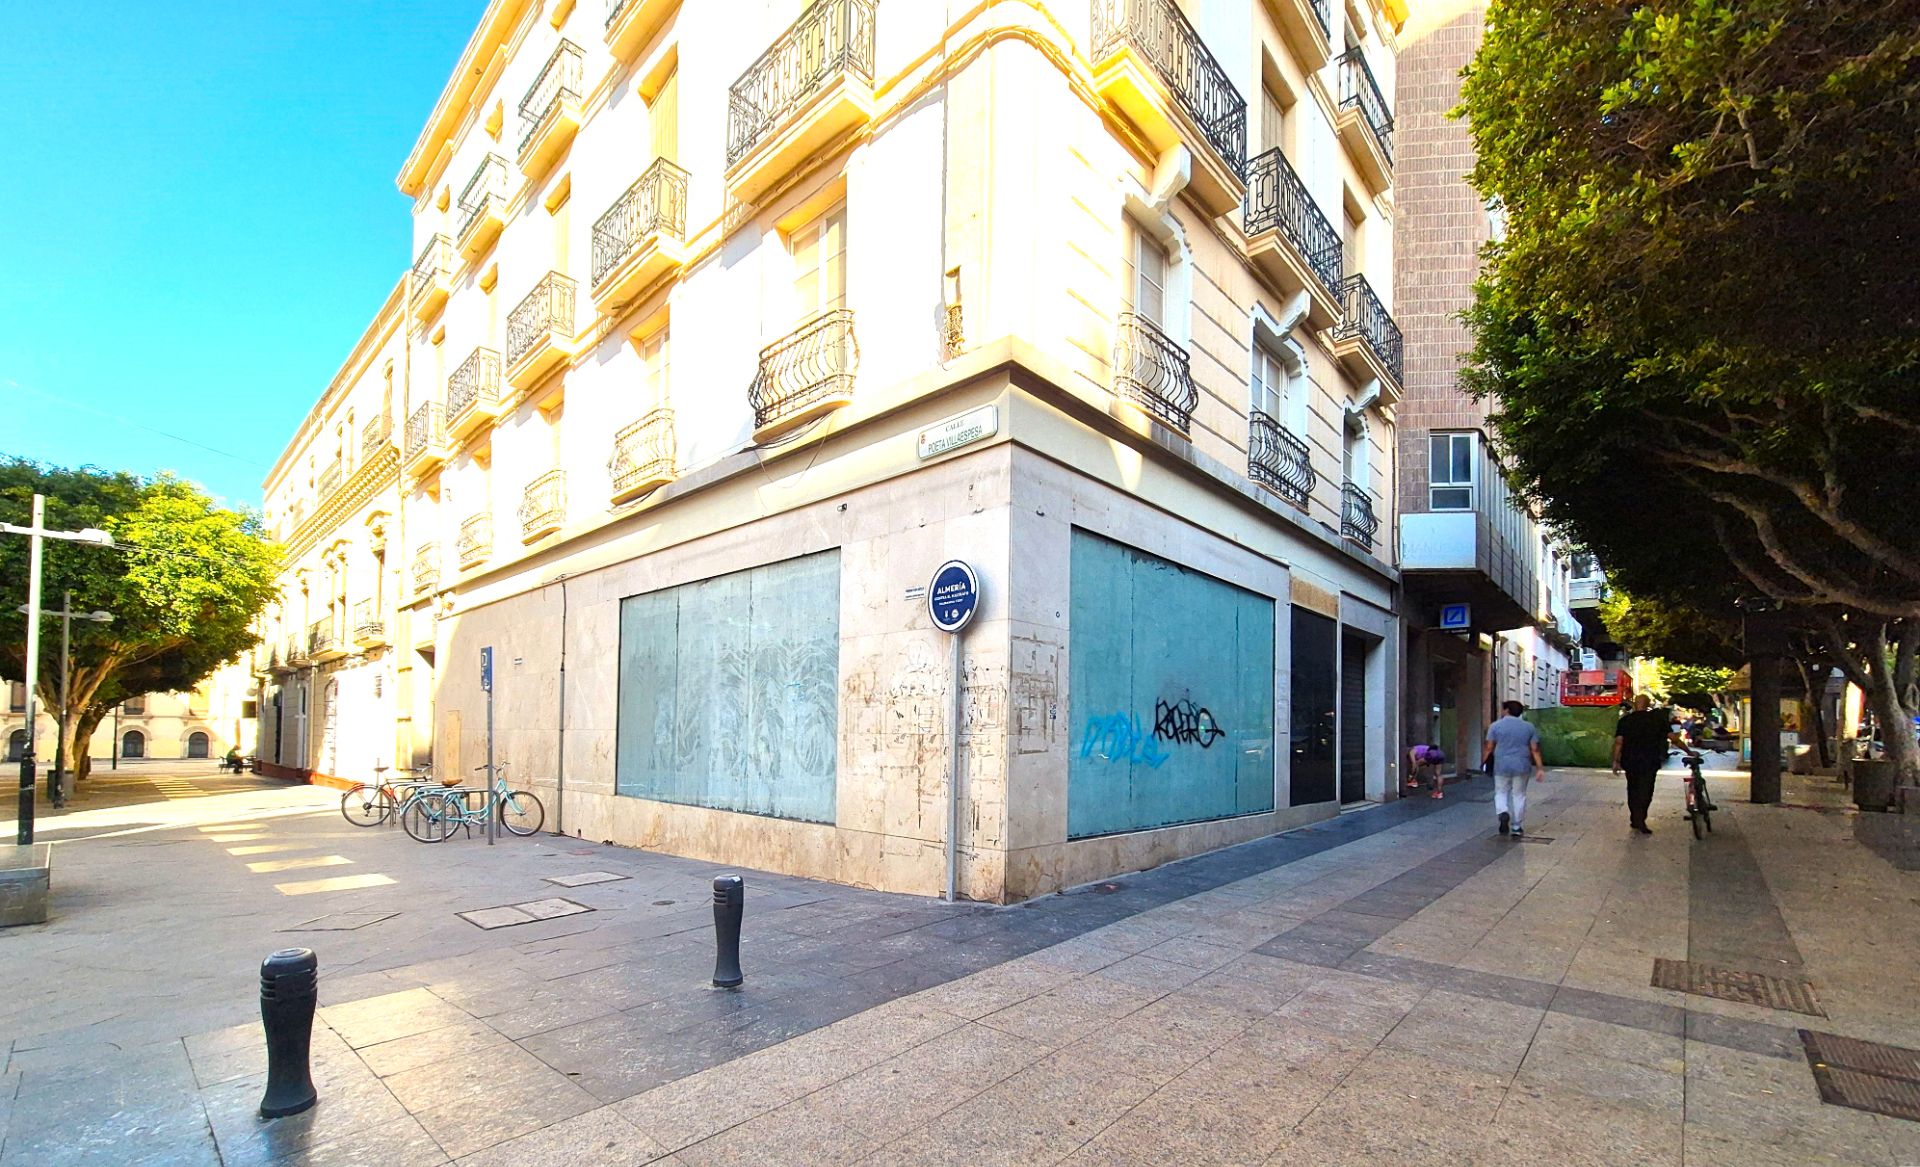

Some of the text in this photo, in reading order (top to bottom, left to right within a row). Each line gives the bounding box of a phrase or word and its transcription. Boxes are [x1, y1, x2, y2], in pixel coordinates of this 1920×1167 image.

[928, 425, 982, 453] POETA VILLAESPESA
[937, 582, 966, 595] ALMERÍA
